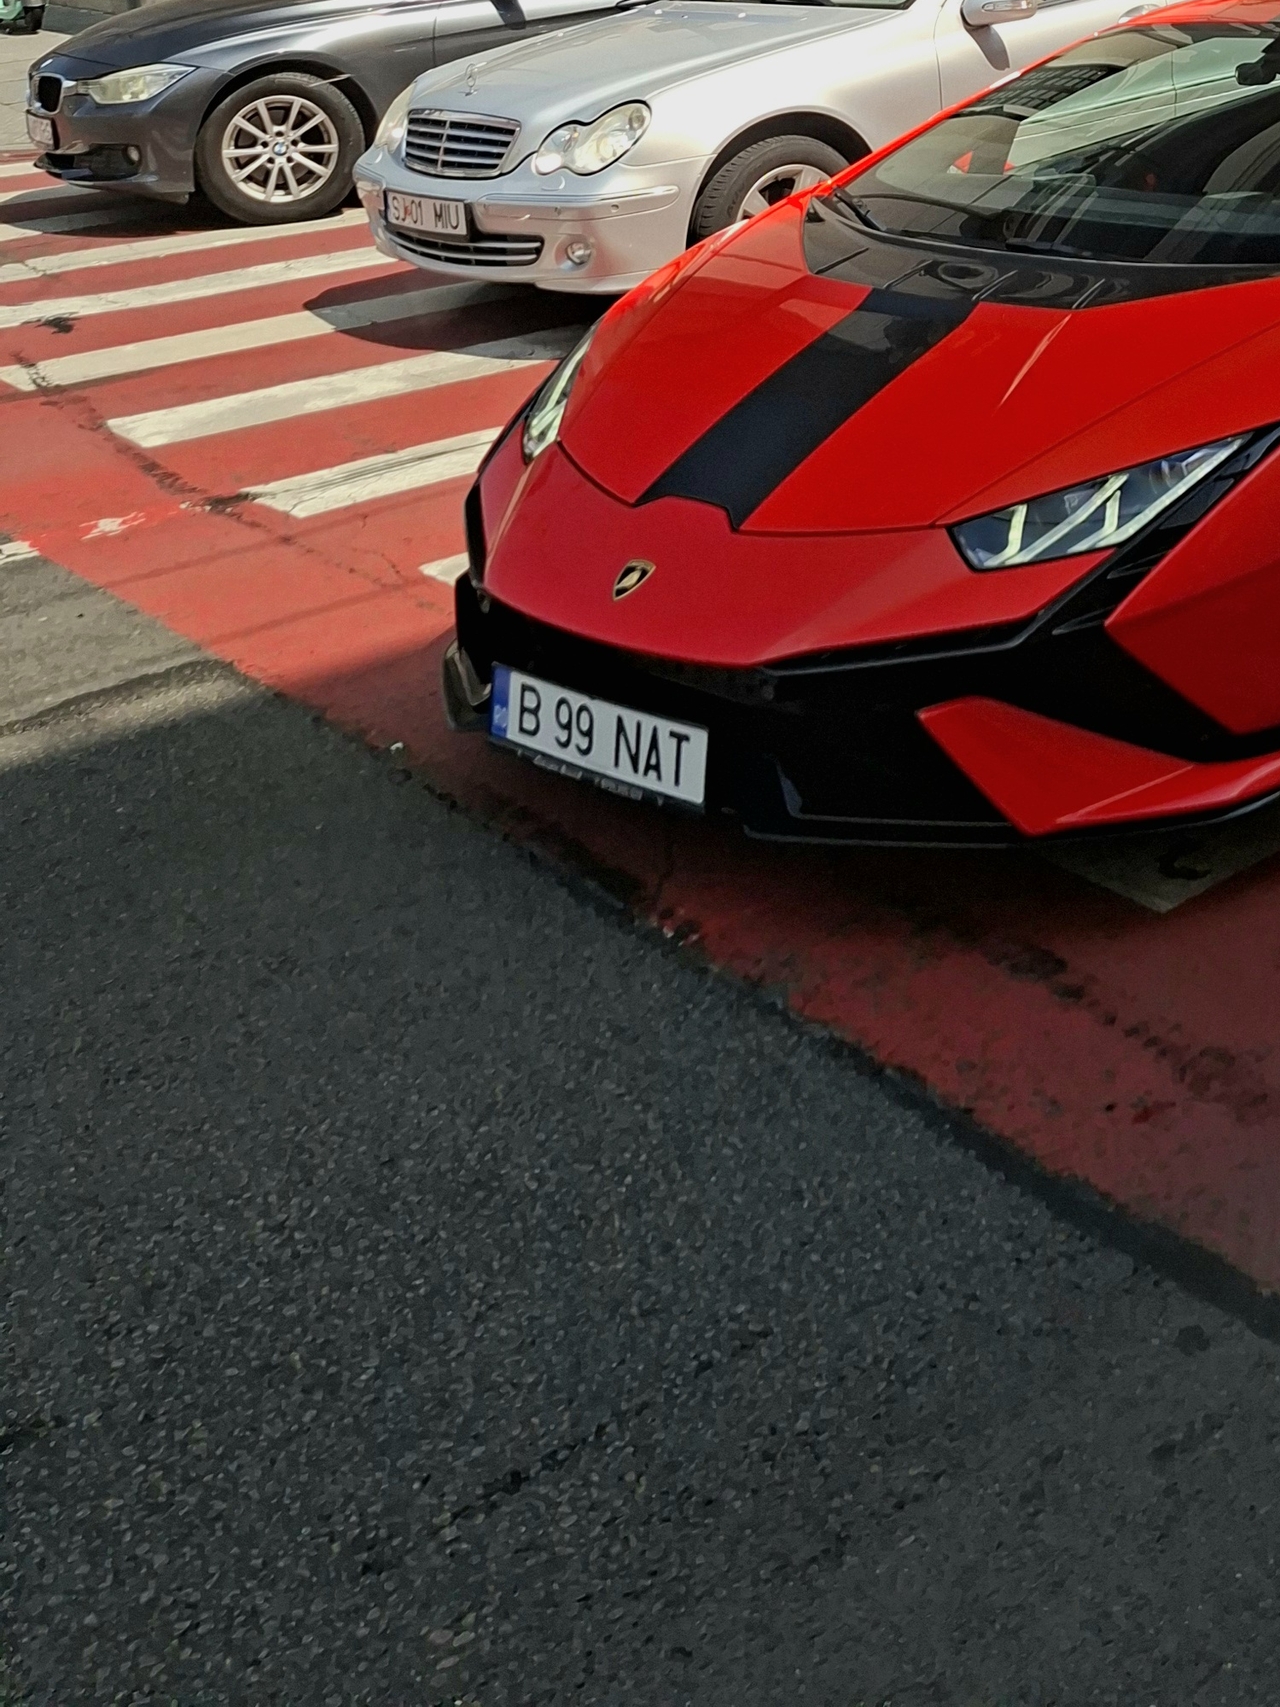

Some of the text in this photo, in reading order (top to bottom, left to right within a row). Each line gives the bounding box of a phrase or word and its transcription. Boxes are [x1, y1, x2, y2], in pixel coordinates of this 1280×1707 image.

[392, 196, 460, 230] SJ 01 MIU
[518, 681, 542, 737] B
[554, 697, 594, 756] 99
[614, 713, 691, 788] NAT
